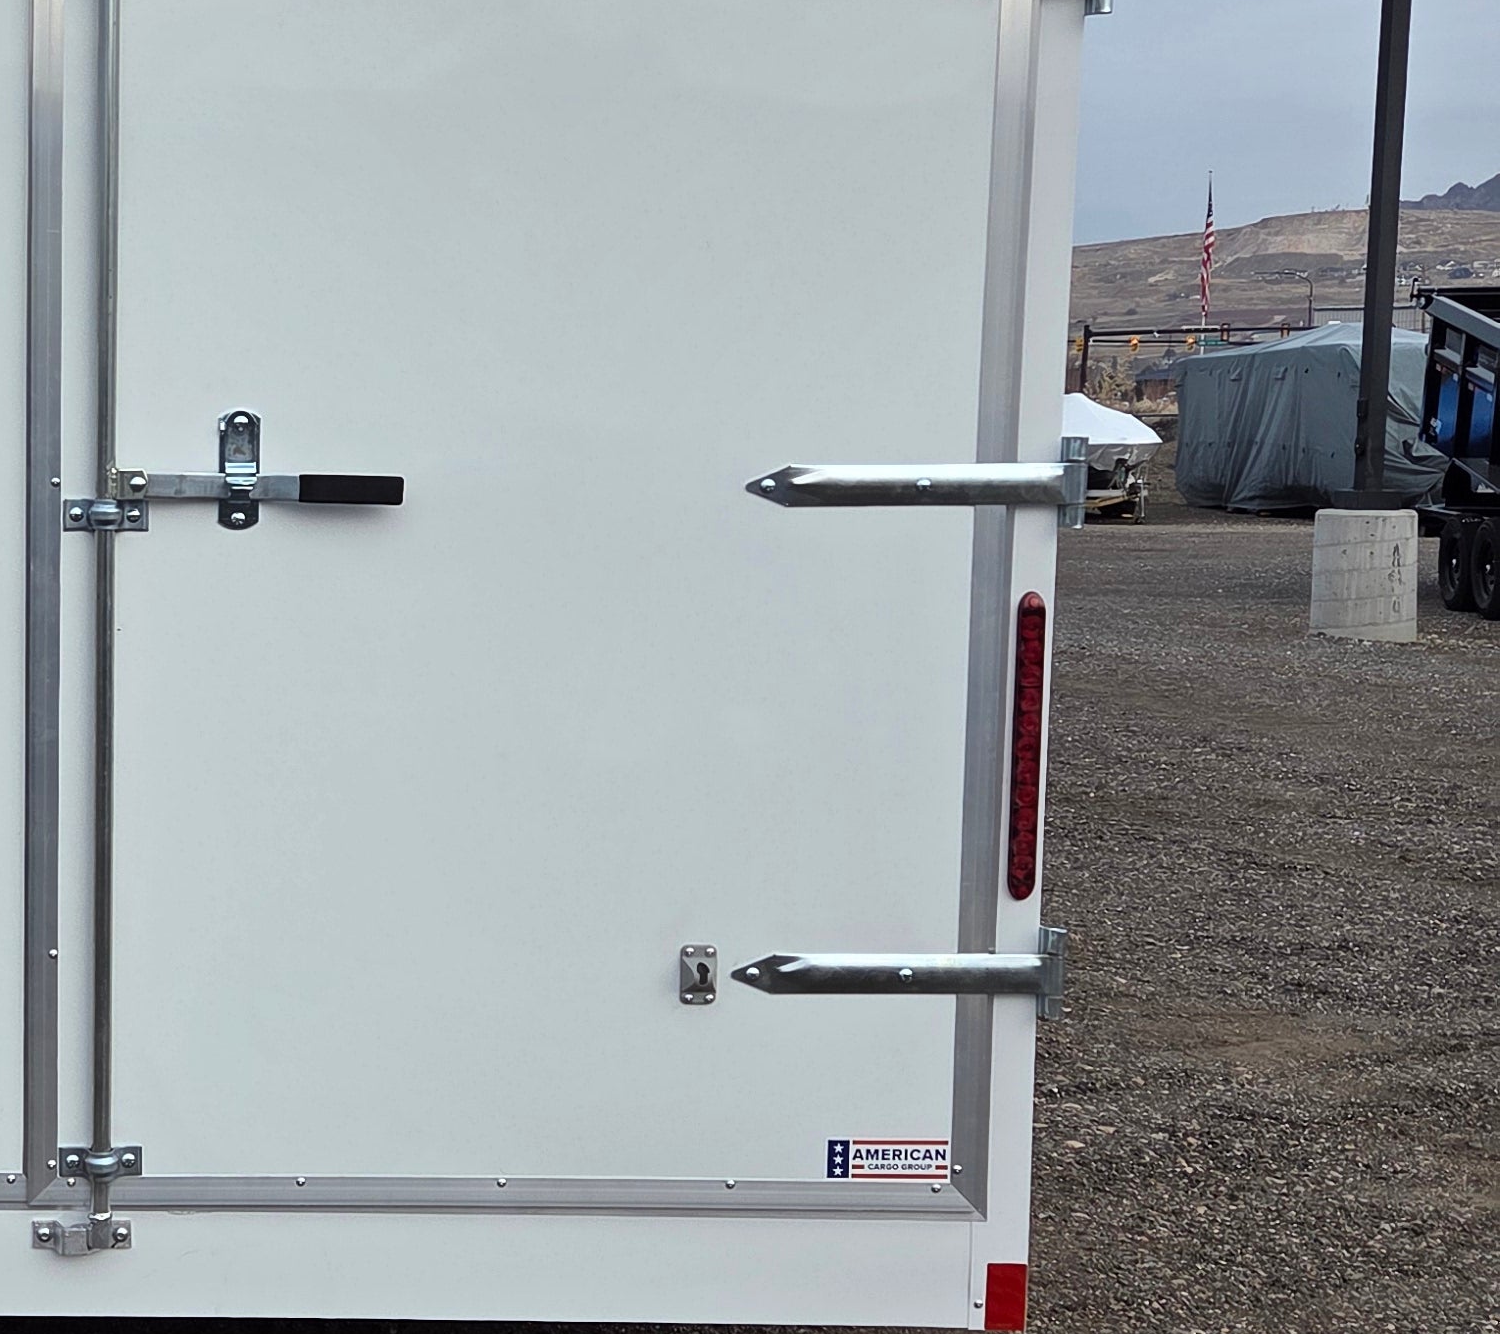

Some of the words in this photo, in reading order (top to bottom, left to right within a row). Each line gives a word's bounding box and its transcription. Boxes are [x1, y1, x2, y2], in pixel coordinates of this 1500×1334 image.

[851, 1148, 947, 1161] AMERICAN
[867, 1163, 899, 1171] CARGO
[900, 1163, 933, 1171] GROUP
